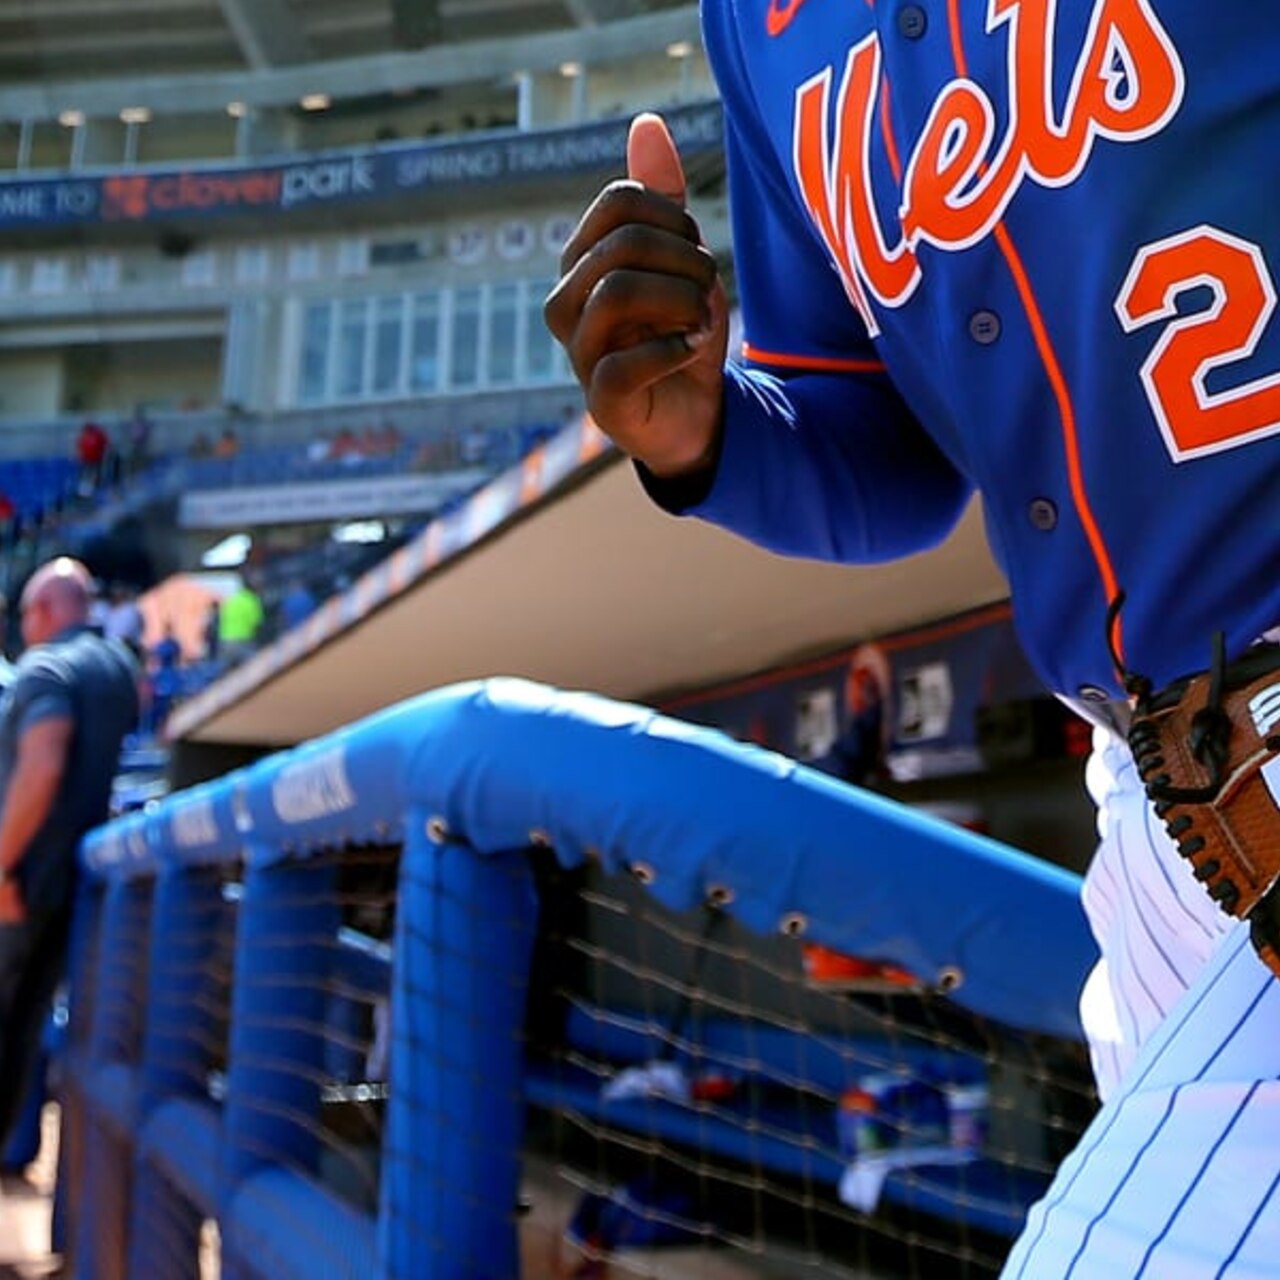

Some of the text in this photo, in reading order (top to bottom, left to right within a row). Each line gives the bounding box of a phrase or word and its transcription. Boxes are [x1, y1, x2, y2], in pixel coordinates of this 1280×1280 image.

[56, 182, 99, 216] TO
[151, 156, 376, 210] cloverpark
[394, 146, 500, 187] SPRING
